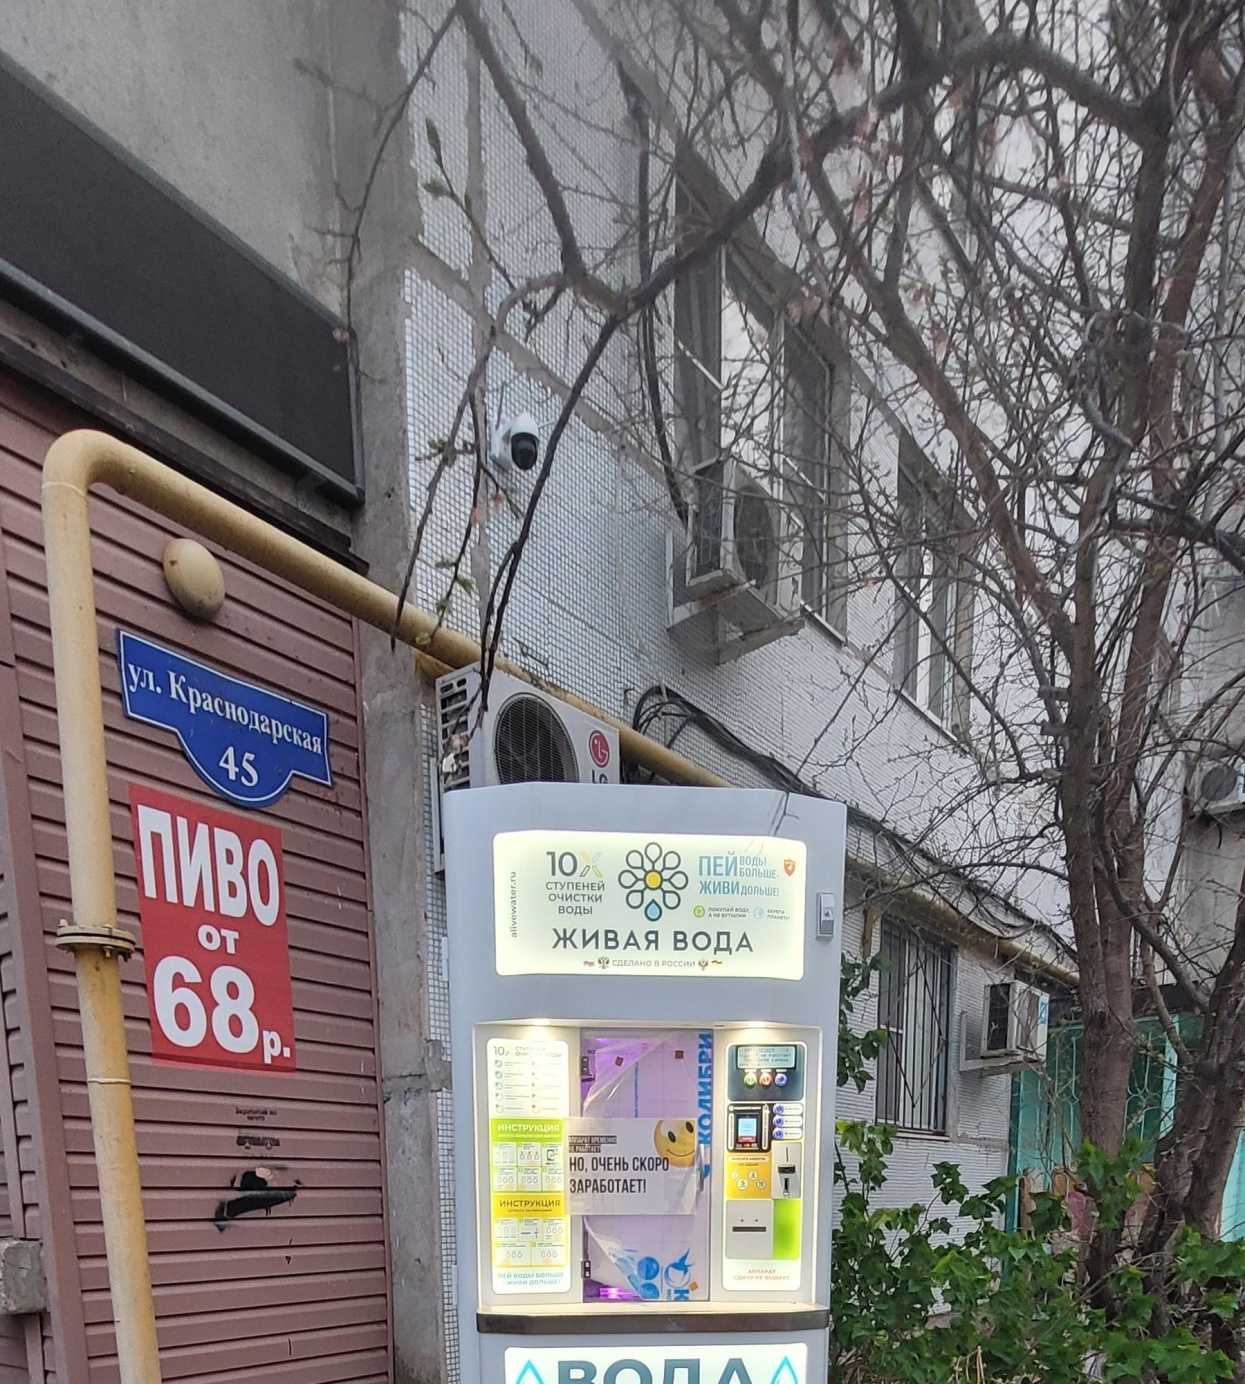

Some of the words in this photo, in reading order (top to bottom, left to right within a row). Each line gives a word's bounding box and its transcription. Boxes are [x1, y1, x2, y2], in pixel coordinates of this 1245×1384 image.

[128, 663, 162, 694] ул.
[168, 670, 322, 755] Краснодарская
[219, 745, 259, 787] 45
[137, 804, 280, 926] ПИВО
[698, 850, 737, 876] ПЕЙ
[545, 880, 605, 892] СТУПЕНЕЙ
[699, 880, 739, 895] ЖИВИ
[509, 871, 518, 938] alivewater.ru
[548, 893, 602, 903] ОЧИСТКИ
[558, 905, 593, 916] ВОДЫ
[552, 928, 660, 951] ЖИВАЯ
[673, 930, 754, 956] ВОДА
[612, 959, 652, 968] СДЕЛАНО
[654, 959, 660, 967] В
[662, 959, 696, 968] РОССИИ
[153, 955, 259, 1053] 68
[262, 1030, 291, 1064] р.
[698, 1032, 713, 1145] КОЛИБРИ
[497, 1123, 560, 1132] ИНСТРУКЦИЯ
[570, 1157, 588, 1172] НО,
[591, 1156, 629, 1171] ОЧЕНЬ
[632, 1157, 669, 1171] СКОРО
[569, 1179, 646, 1193] ЗАРАБОТАЕТ!
